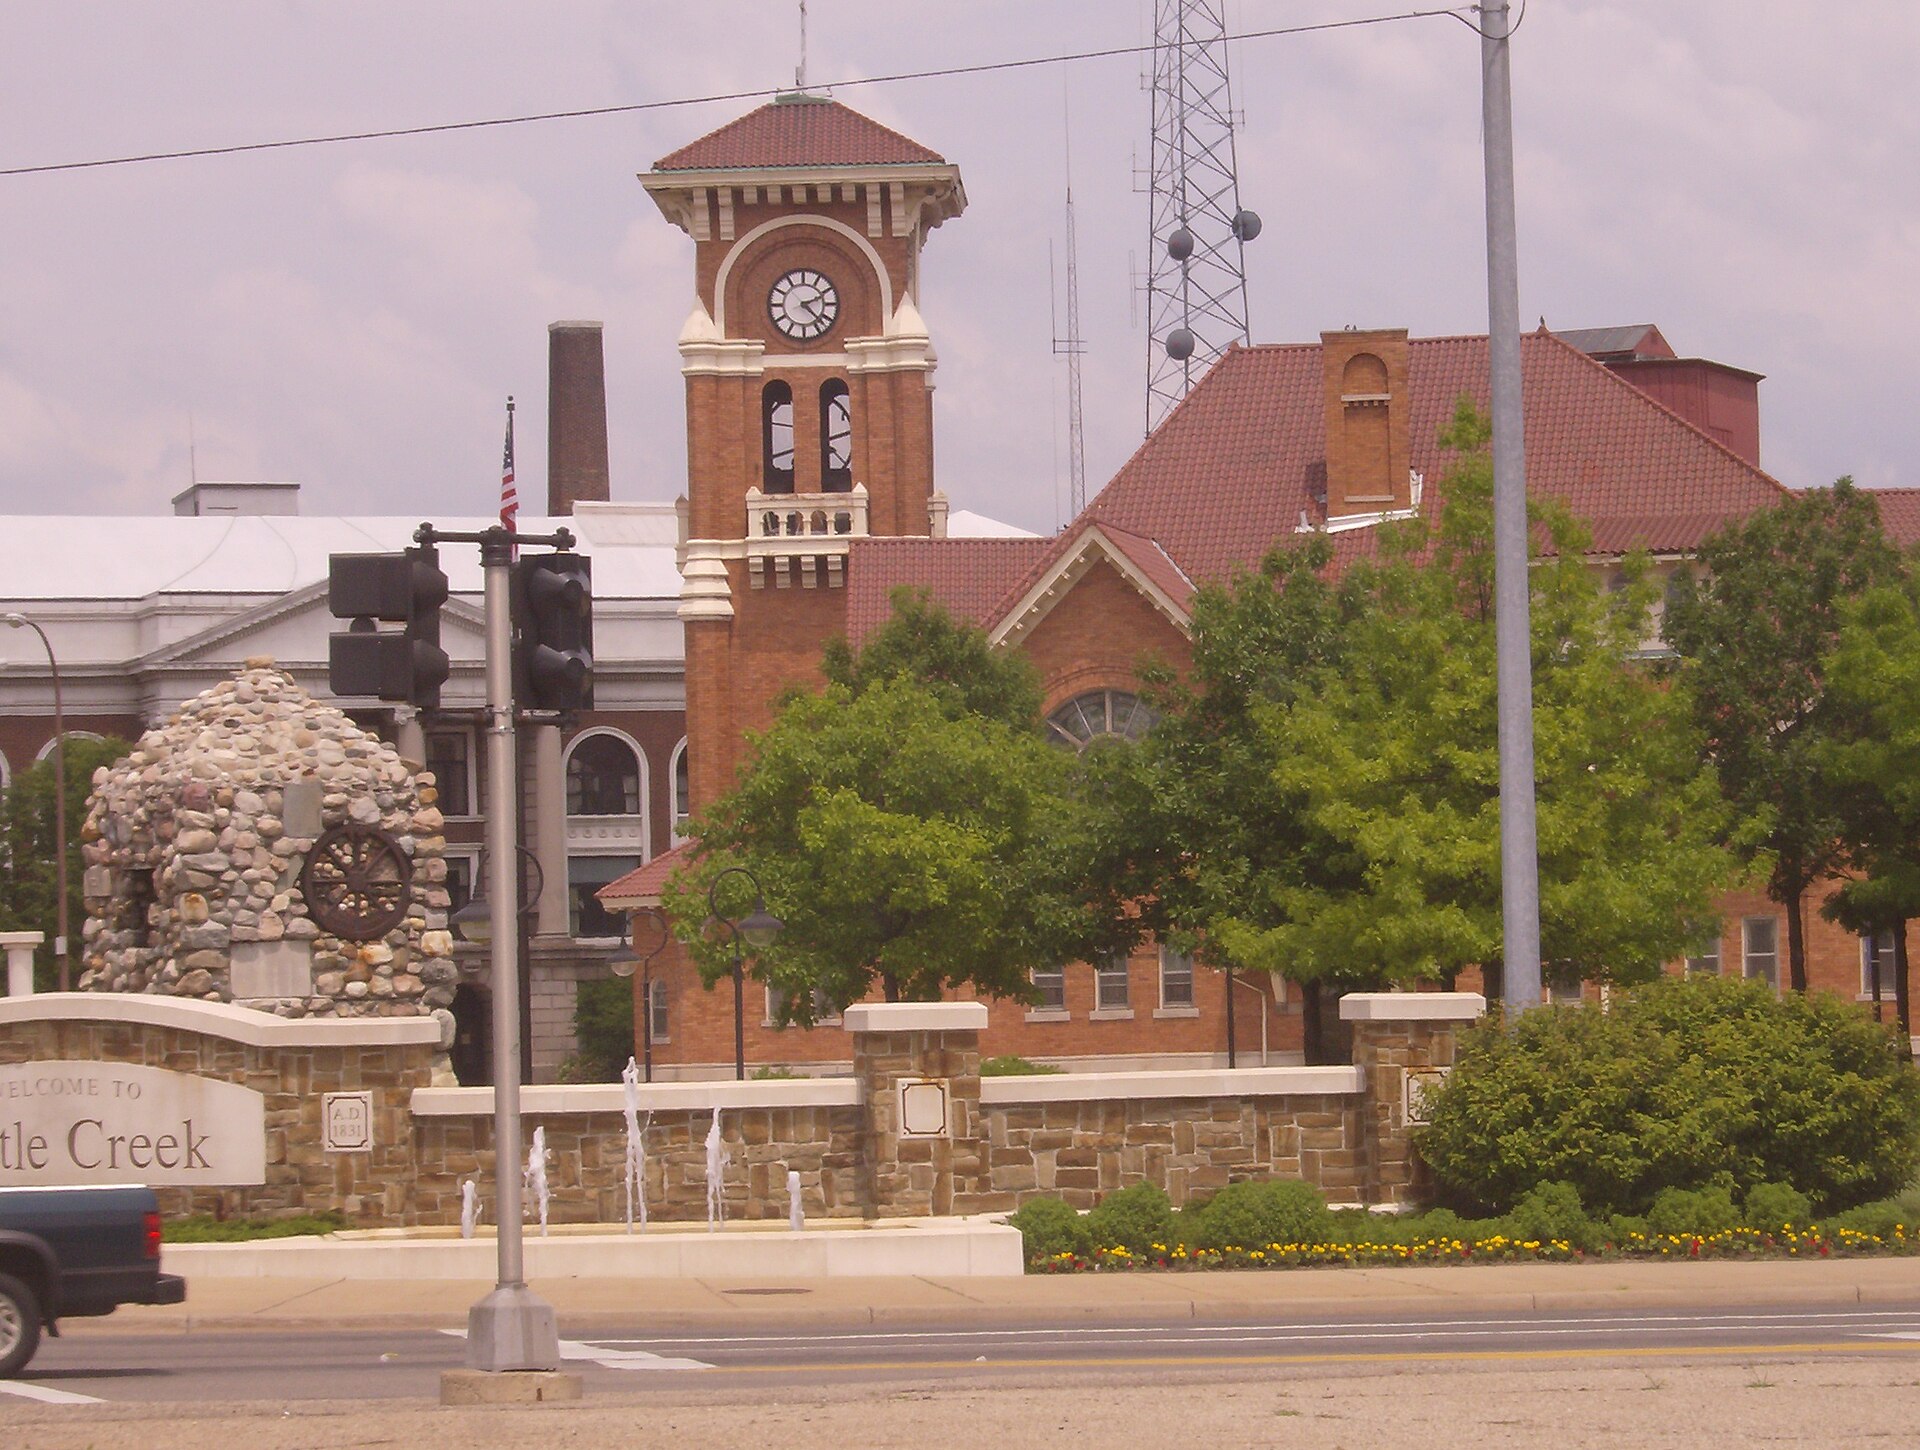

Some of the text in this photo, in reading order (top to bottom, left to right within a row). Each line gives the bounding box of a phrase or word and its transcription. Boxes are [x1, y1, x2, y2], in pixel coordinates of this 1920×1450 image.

[0, 1078, 142, 1099] ELCOME TO
[333, 1125, 361, 1137] 1831
[67, 1118, 213, 1169] Creek
